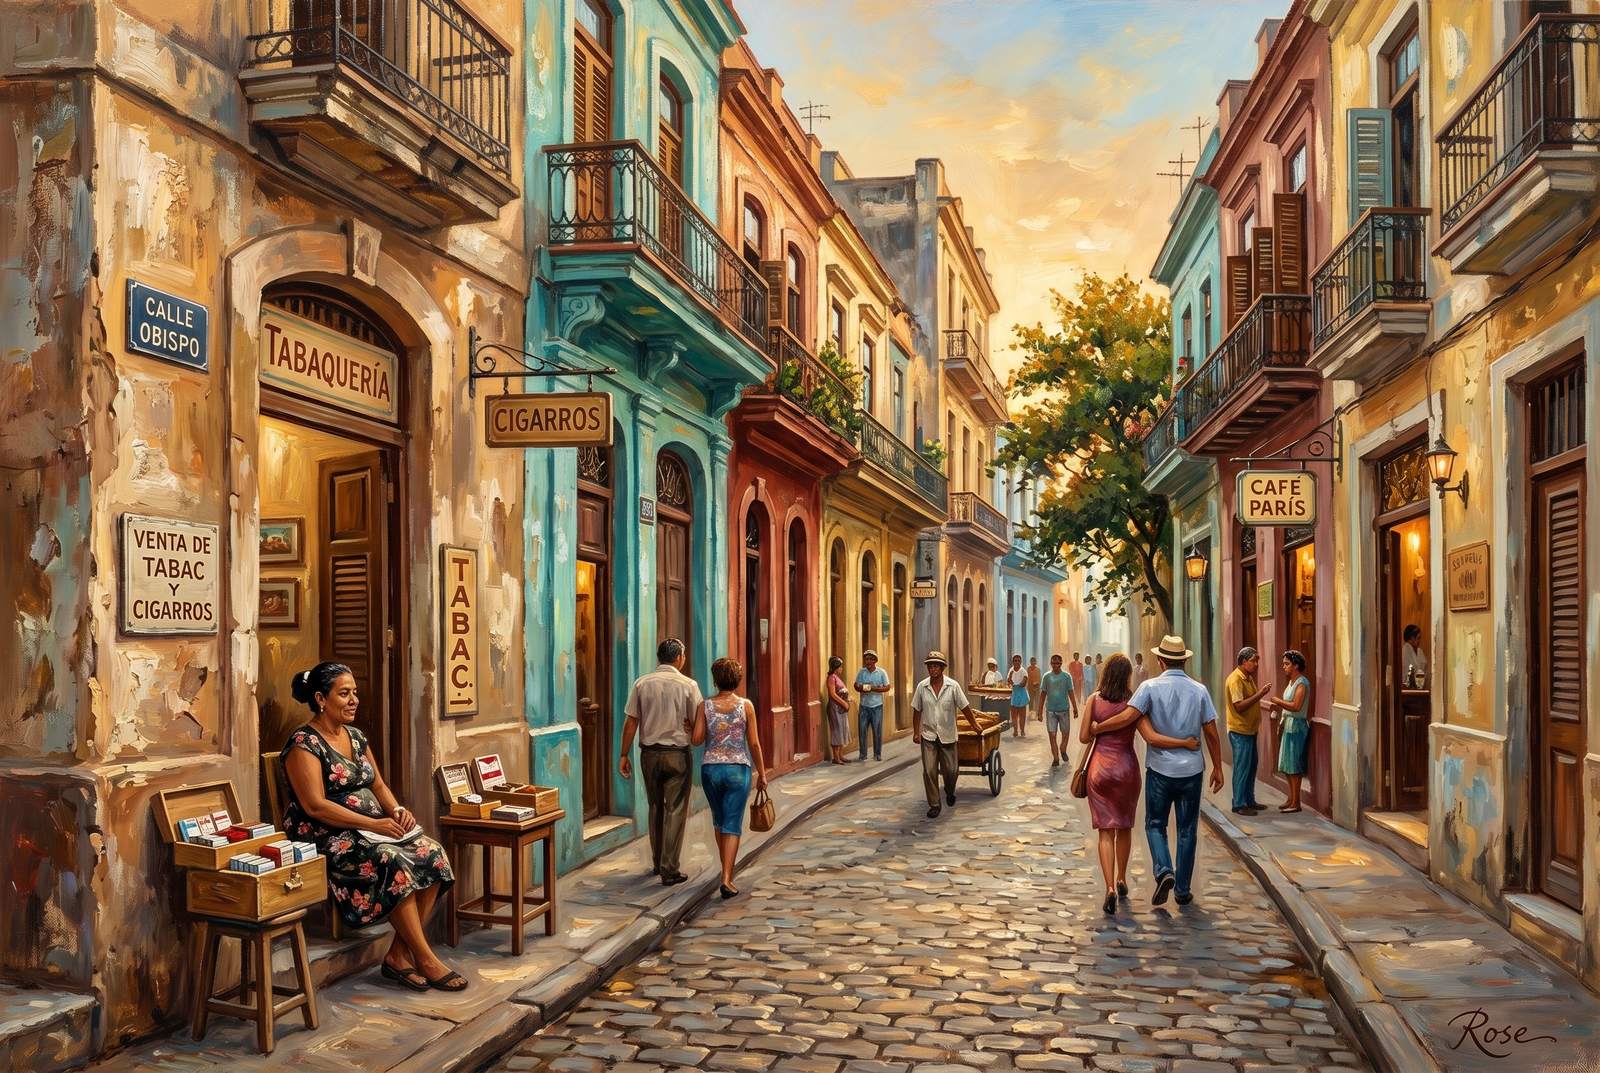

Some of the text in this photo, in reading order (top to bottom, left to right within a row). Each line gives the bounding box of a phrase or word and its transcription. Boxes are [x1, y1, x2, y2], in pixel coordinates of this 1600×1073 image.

[146, 297, 194, 328] CALLE
[140, 322, 199, 358] OBISPO
[494, 406, 600, 432] CIGARROS
[1250, 475, 1301, 495] CAFÉ
[1250, 497, 1306, 516] PARÍS
[134, 529, 211, 555] VENTA DE
[142, 556, 205, 580] TABAC
[168, 582, 180, 597] Y
[133, 600, 213, 621] CIGARROS
[1447, 1007, 1557, 1059] Rose
